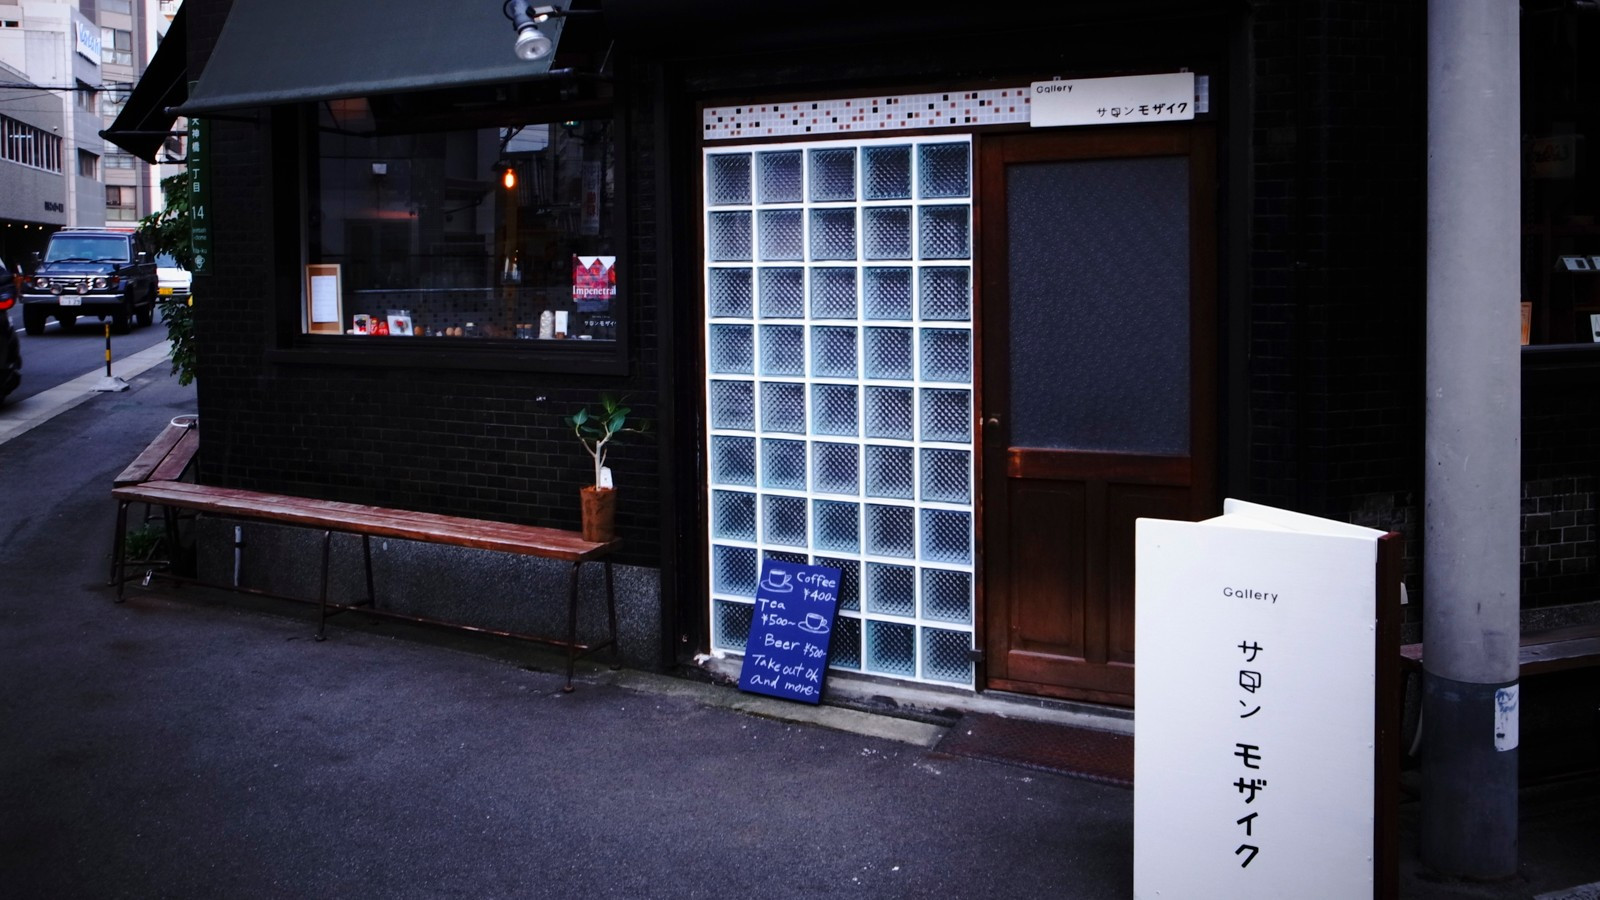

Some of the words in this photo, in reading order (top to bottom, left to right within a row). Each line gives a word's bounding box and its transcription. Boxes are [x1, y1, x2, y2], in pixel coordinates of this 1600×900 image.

[1036, 84, 1073, 94] Gallery
[191, 205, 204, 220] 14
[796, 571, 836, 588] Coffee
[1223, 587, 1279, 603] Gallery
[758, 598, 786, 612] Tea
[764, 633, 800, 651] Beer
[752, 654, 780, 672] Take
[782, 662, 804, 677] out
[750, 675, 780, 689] and
